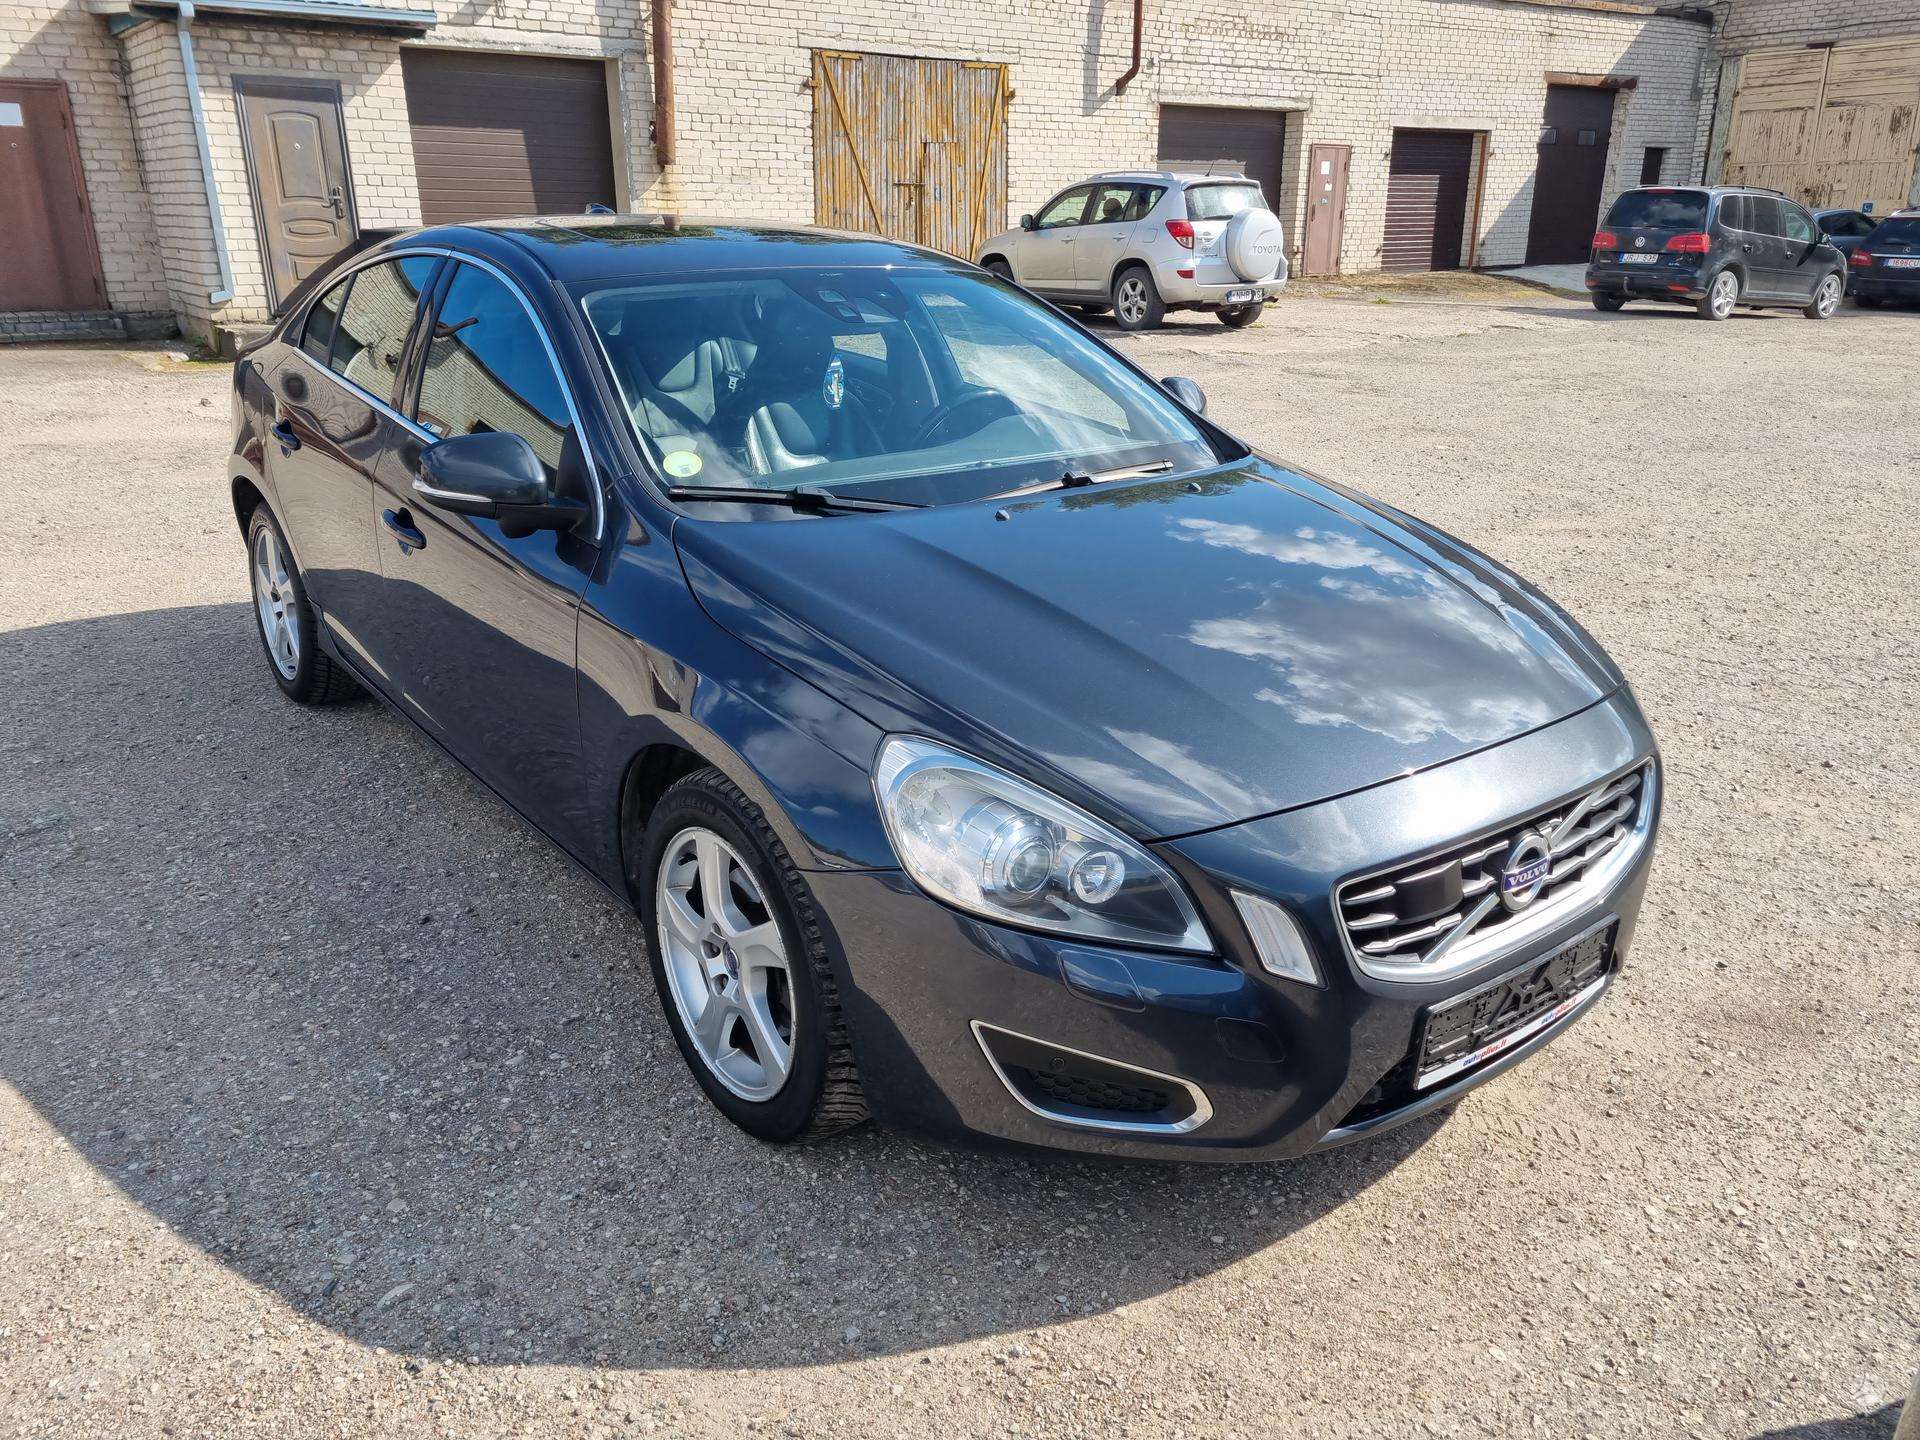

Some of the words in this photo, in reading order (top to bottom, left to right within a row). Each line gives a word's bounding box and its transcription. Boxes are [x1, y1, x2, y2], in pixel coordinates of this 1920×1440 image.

[1252, 244, 1281, 254] TOYOTA
[1508, 862, 1548, 886] VOLVO
[1462, 1039, 1508, 1067] autoplius.lt
